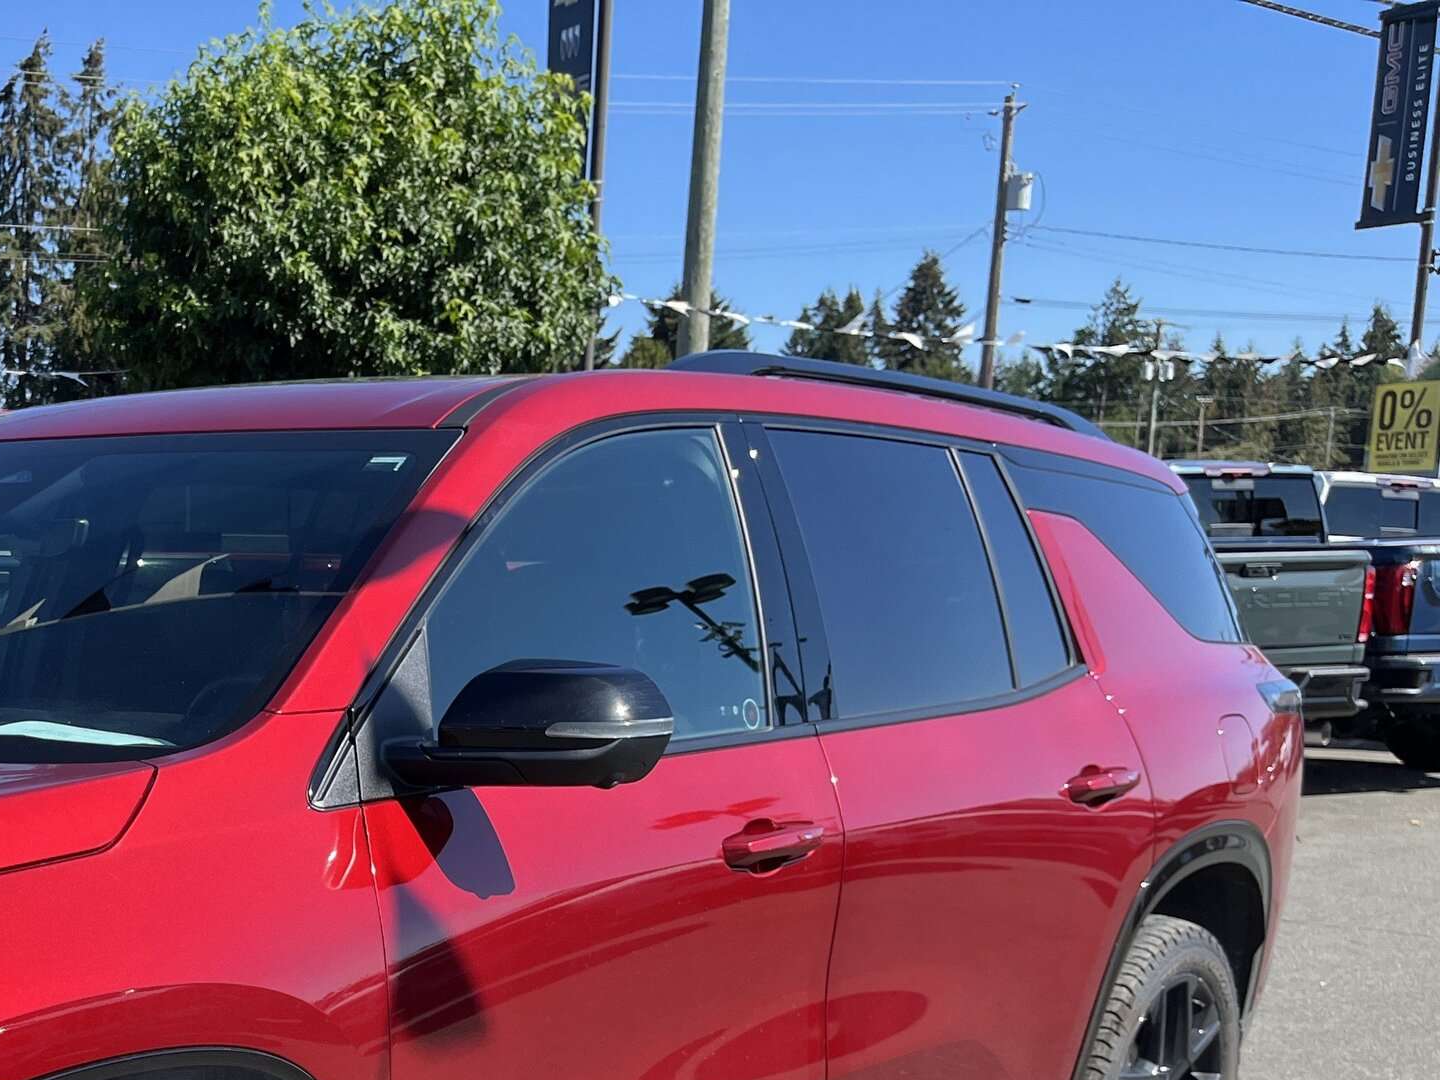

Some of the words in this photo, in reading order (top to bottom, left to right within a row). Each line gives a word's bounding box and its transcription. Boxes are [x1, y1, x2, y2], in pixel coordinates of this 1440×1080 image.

[1381, 21, 1406, 116] GMC
[1405, 100, 1423, 182] BUSINESS
[1416, 44, 1431, 91] ELITE
[1376, 431, 1429, 451] EVENT
[1379, 387, 1432, 430] 0%
